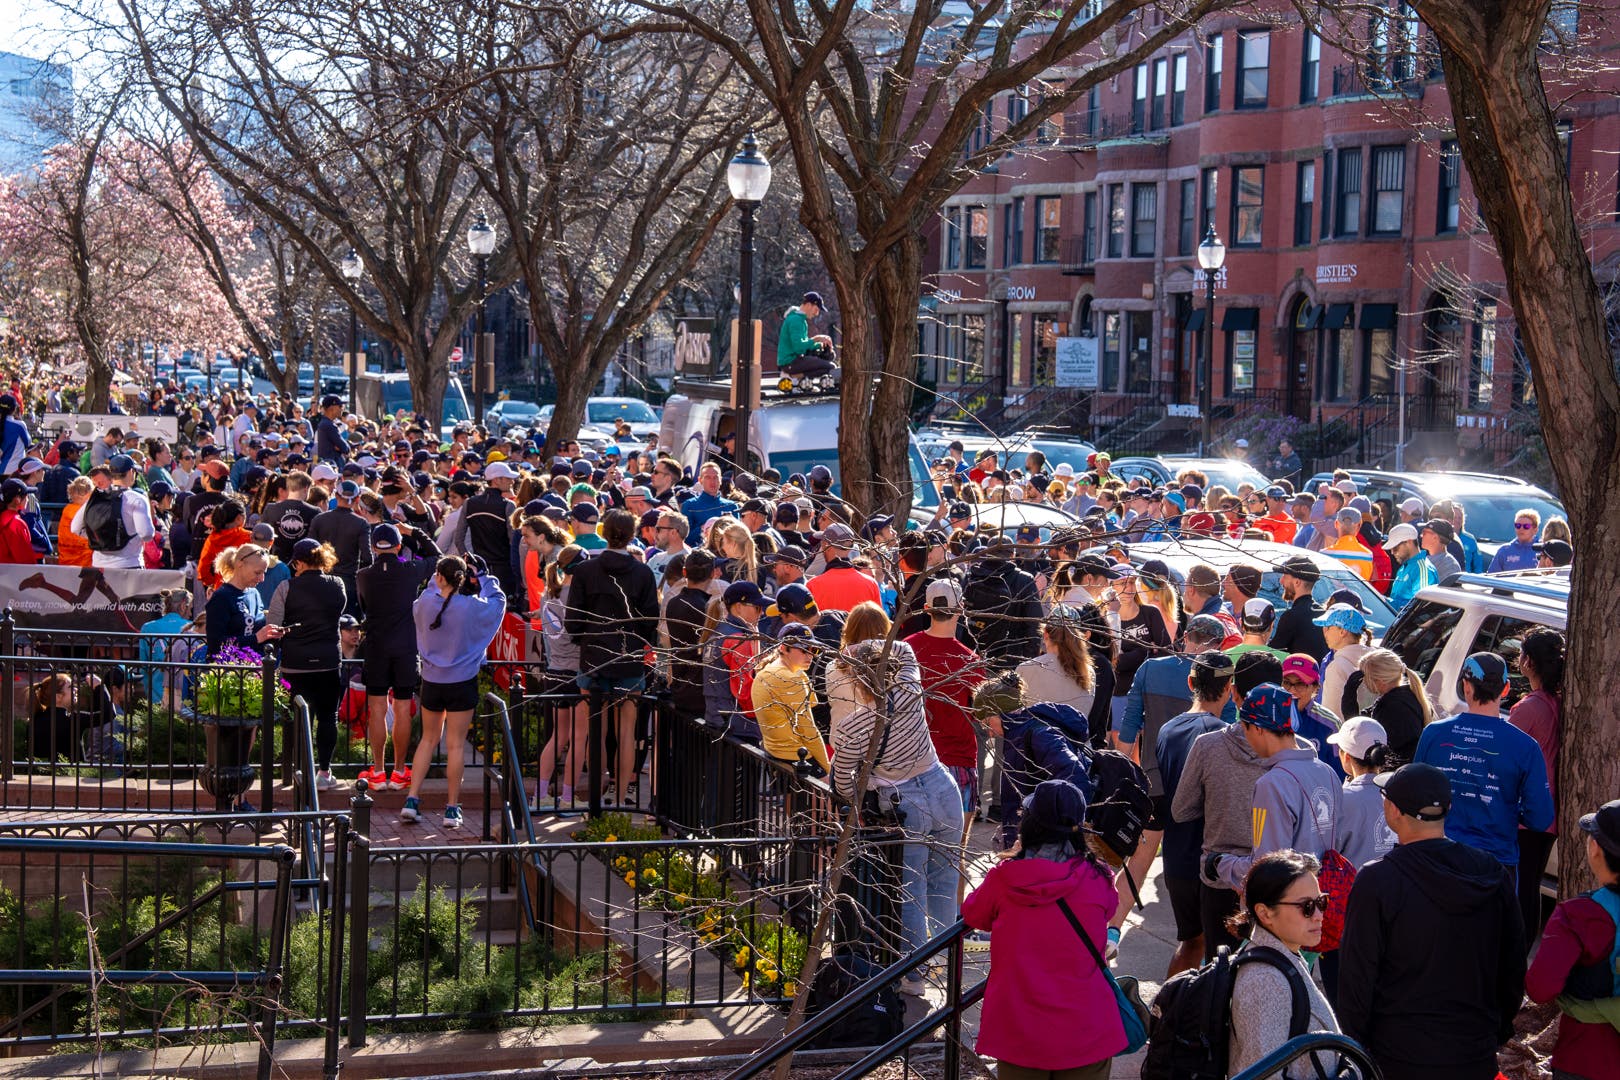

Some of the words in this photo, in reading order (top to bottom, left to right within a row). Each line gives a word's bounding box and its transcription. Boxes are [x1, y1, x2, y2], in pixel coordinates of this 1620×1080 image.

[8, 599, 42, 609] Boston,
[45, 601, 69, 609] move
[72, 603, 91, 612] your
[93, 602, 116, 611] mind
[118, 602, 137, 611] with
[138, 602, 165, 612] ASICS
